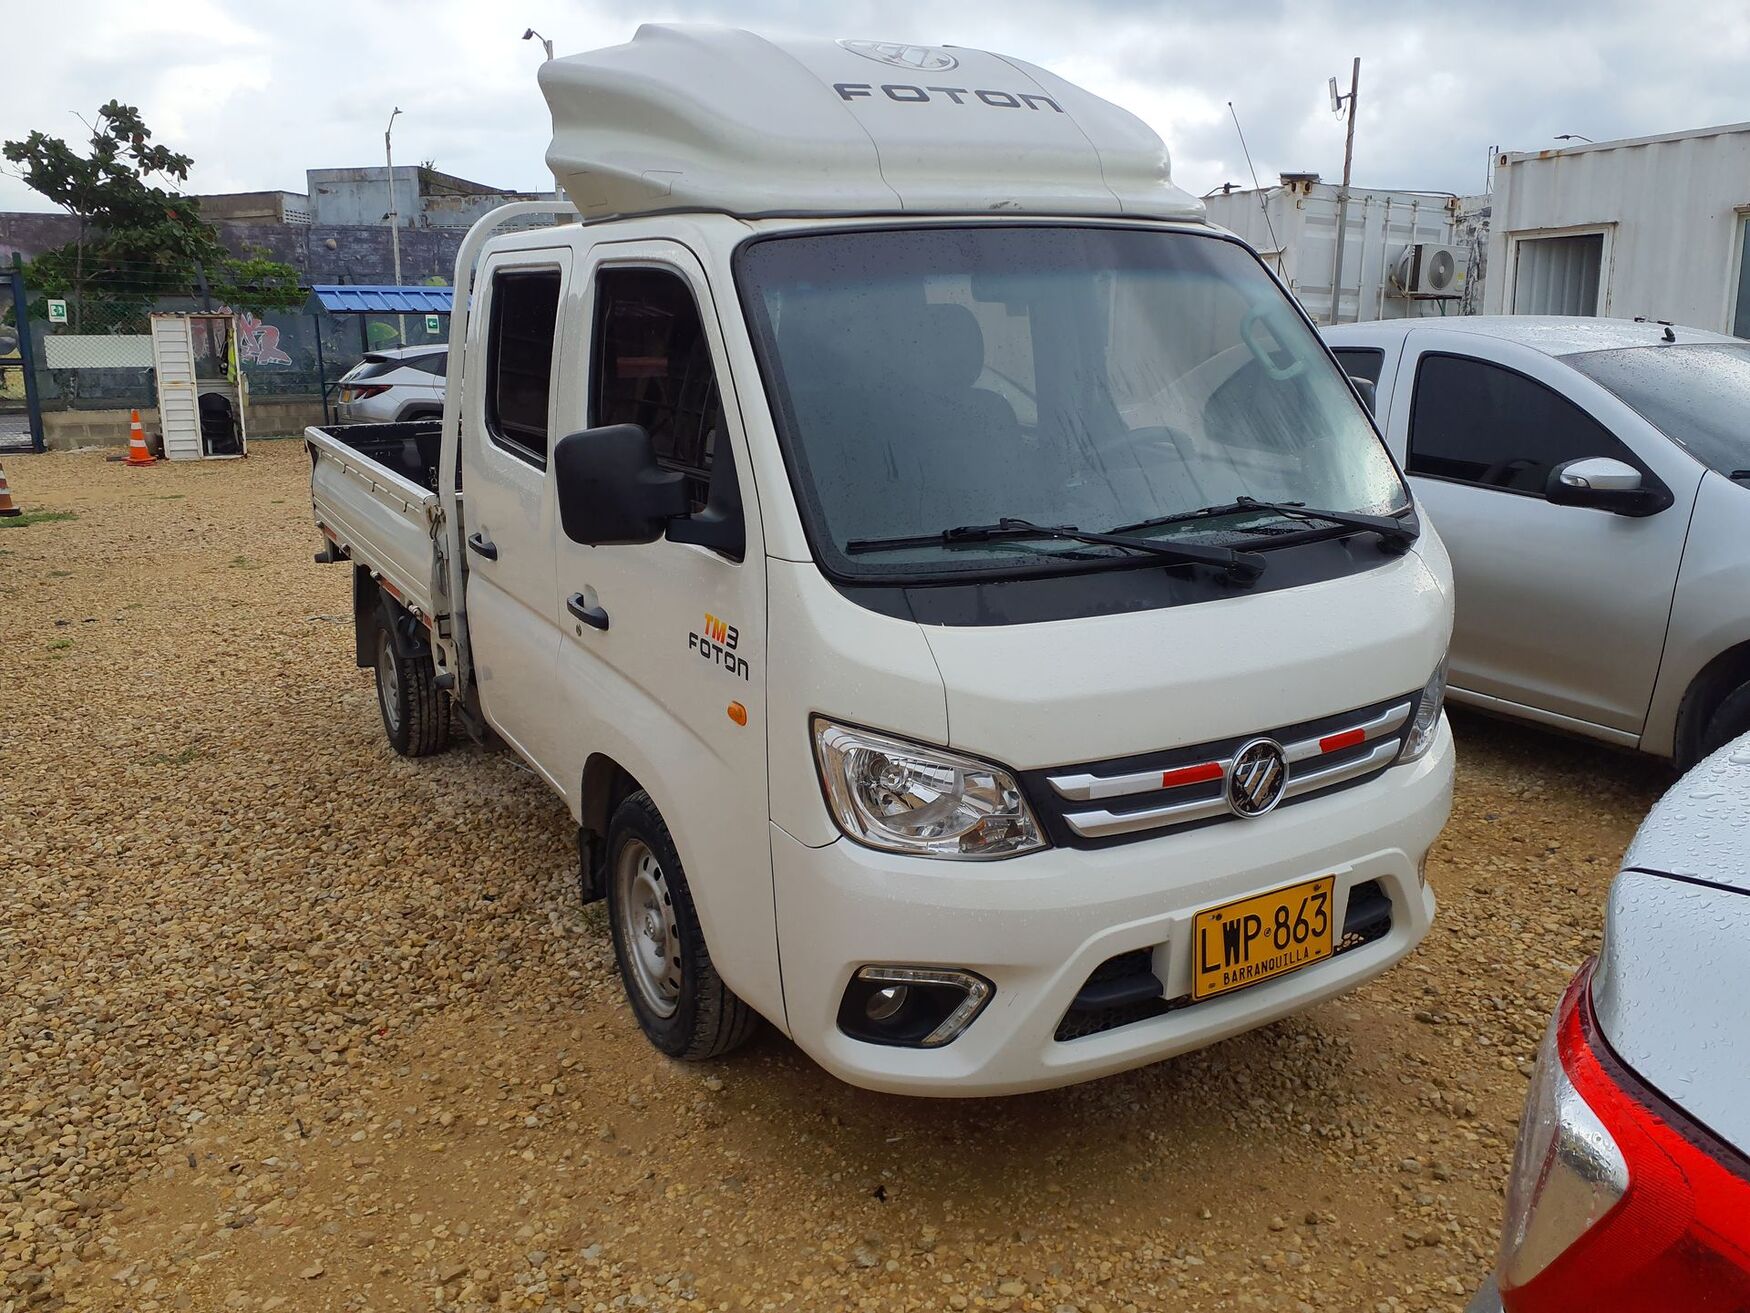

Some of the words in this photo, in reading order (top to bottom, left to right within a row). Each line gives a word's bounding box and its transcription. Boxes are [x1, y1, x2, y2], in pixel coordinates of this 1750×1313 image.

[833, 84, 1064, 113] FOTON
[704, 612, 739, 650] TM3
[688, 631, 749, 681] FOTON
[1201, 914, 1262, 974] LWP
[1273, 891, 1328, 950] 863
